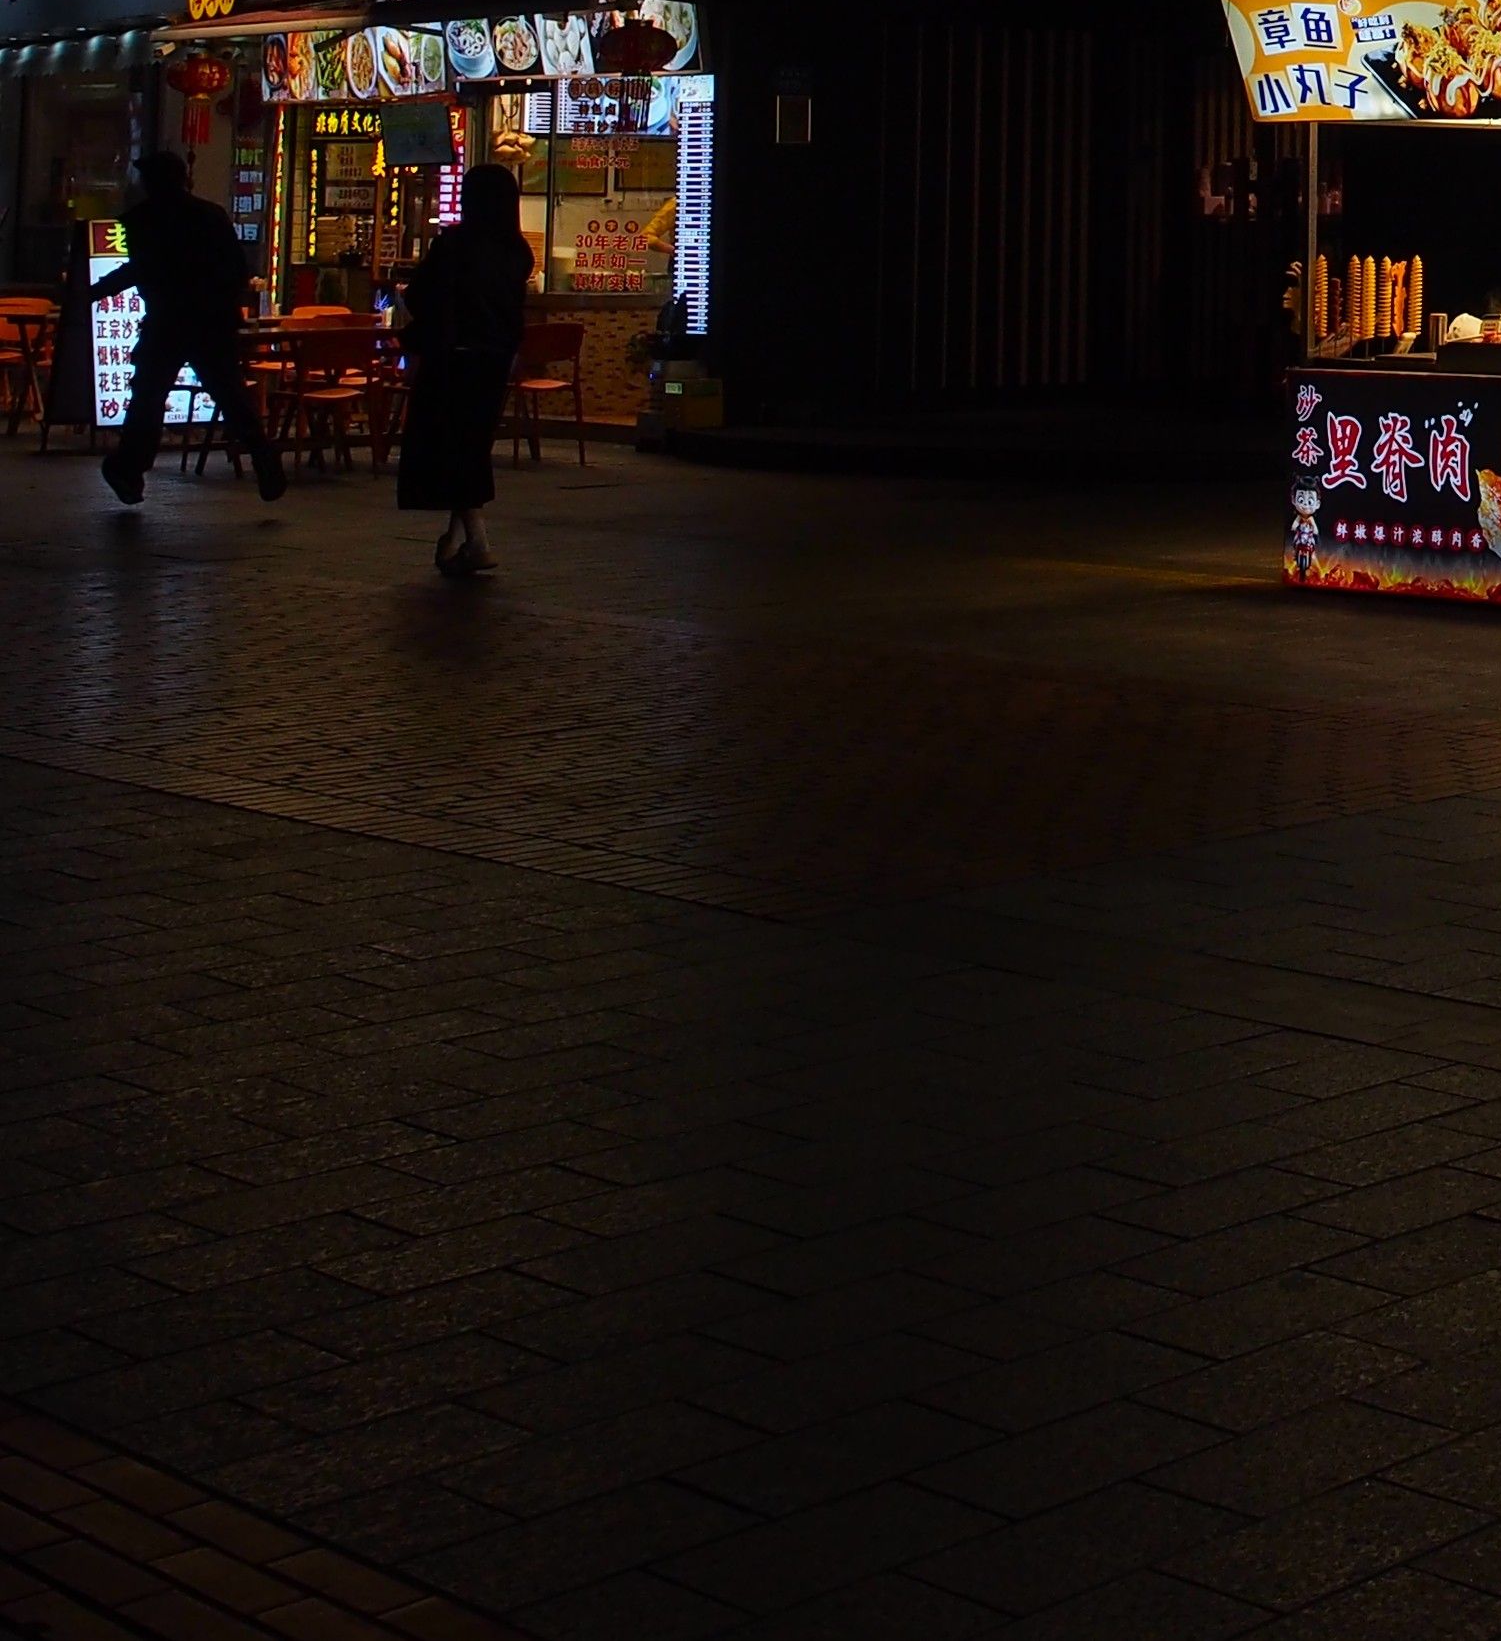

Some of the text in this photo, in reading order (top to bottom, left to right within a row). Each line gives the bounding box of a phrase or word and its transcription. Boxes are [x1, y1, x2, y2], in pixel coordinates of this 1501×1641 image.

[1258, 7, 1336, 49] 章鱼
[1257, 64, 1368, 113] 小丸子
[576, 235, 648, 251] 30年老店
[576, 254, 646, 269] 品质如一
[575, 273, 643, 291] 真材实料
[1292, 385, 1324, 466] 沙茶
[1322, 411, 1472, 502] 里脊肉
